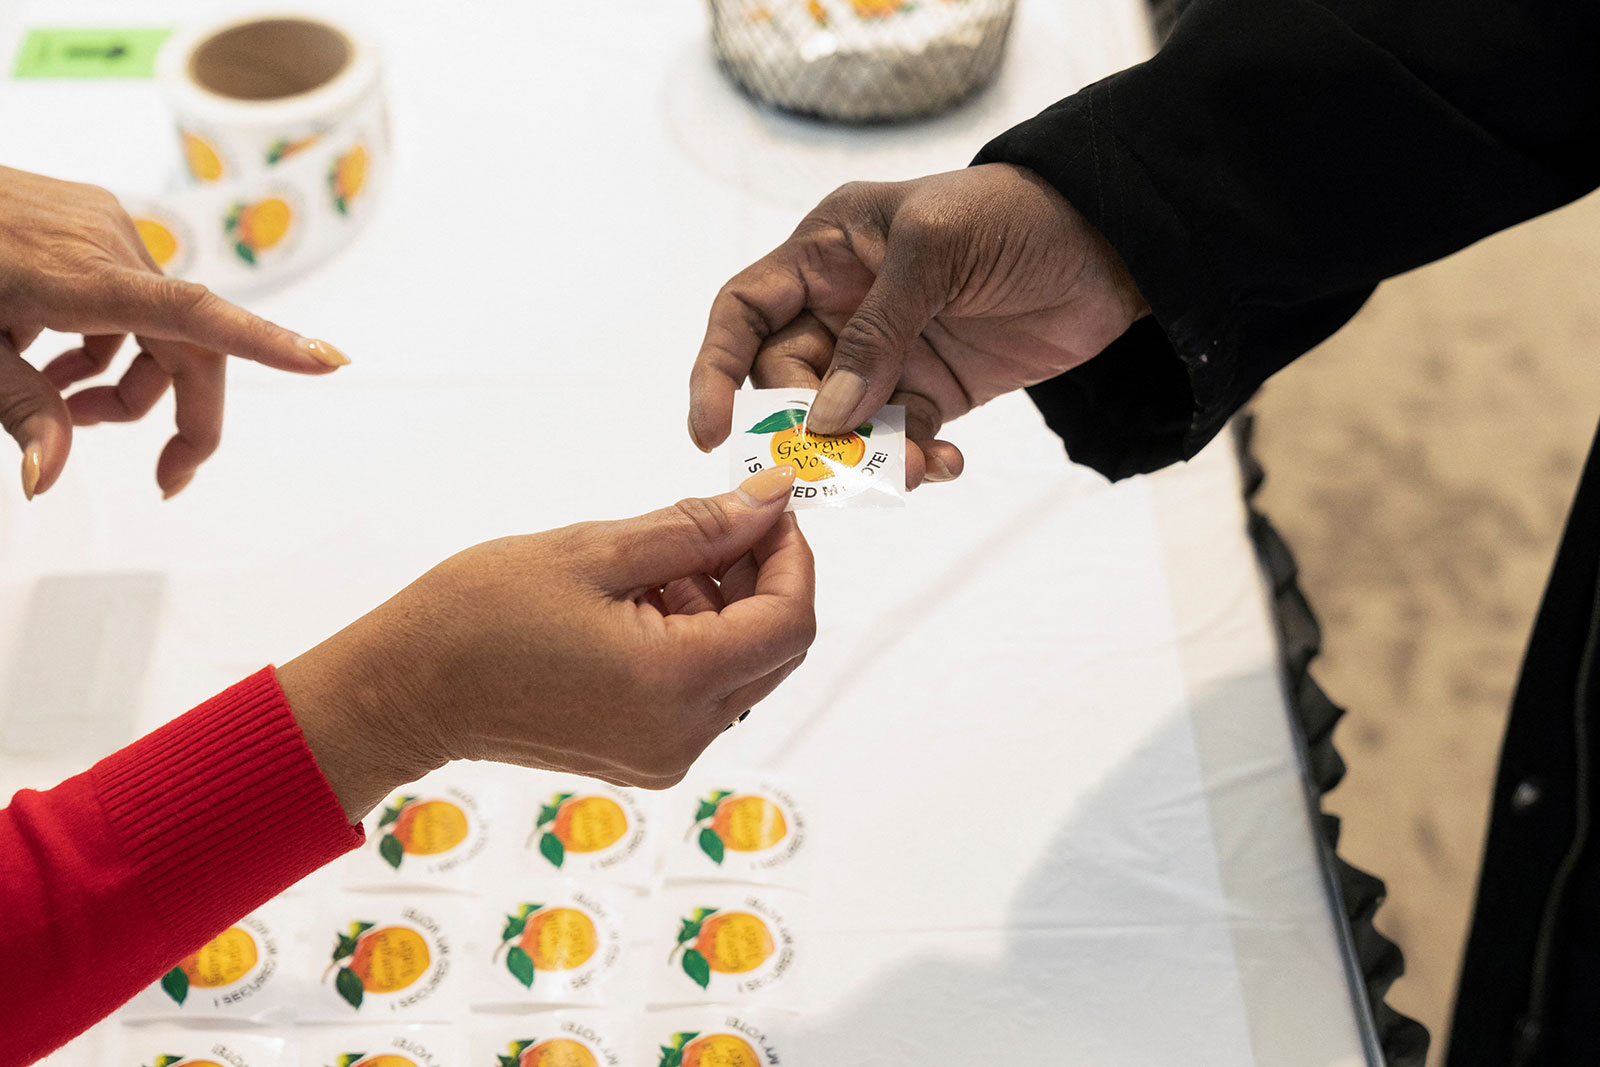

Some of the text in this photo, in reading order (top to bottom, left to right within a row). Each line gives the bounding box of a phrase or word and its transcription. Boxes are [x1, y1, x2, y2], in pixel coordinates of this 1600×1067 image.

[777, 437, 854, 460] Georgia
[860, 451, 890, 477] OTE!
[763, 1046, 780, 1065] MY
